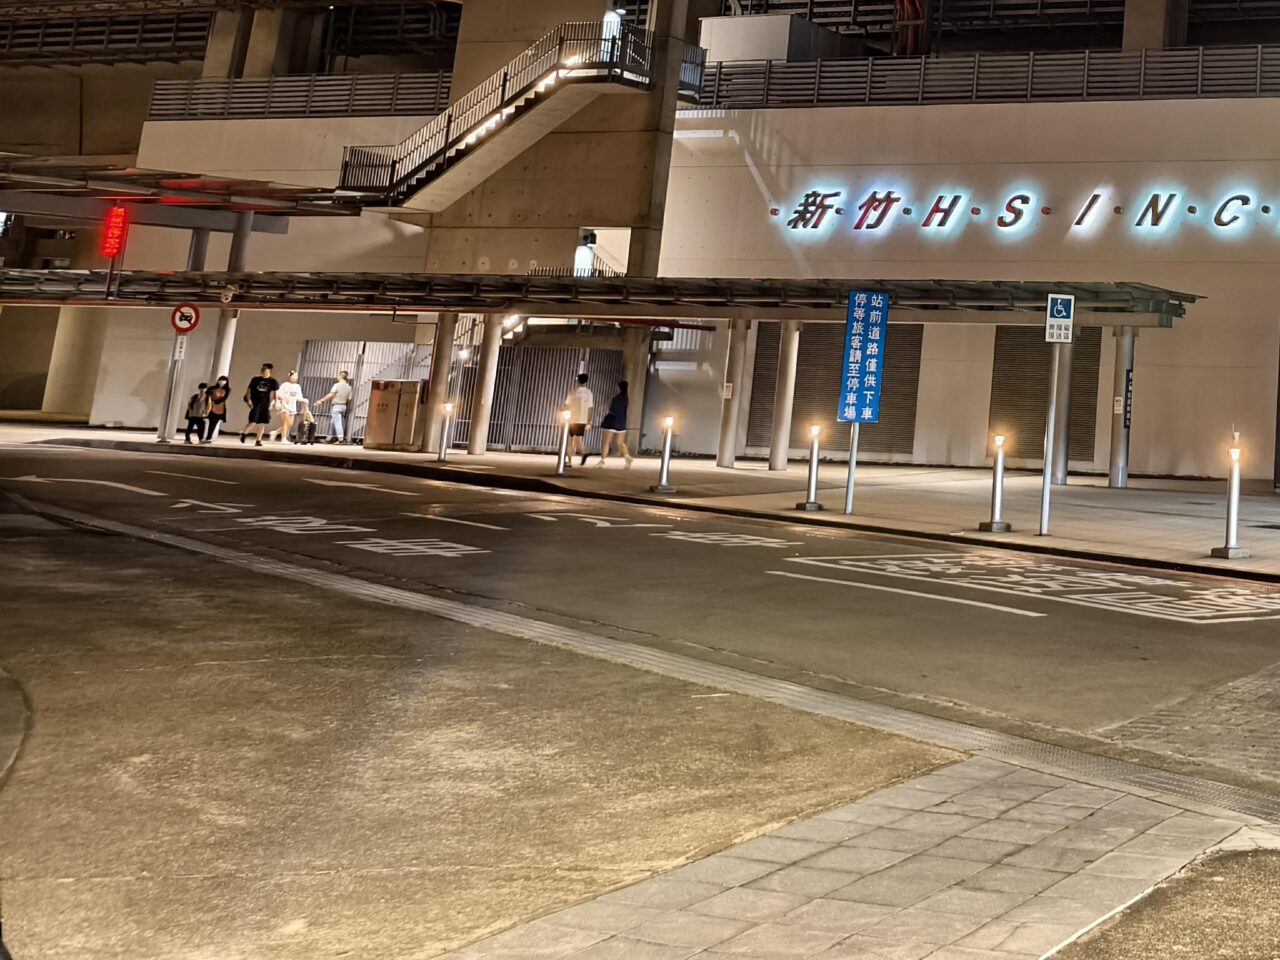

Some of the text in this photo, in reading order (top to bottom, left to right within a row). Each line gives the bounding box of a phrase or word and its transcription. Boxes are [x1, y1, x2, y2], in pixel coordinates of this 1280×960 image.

[787, 190, 901, 230] 新竹
[843, 292, 868, 420] 停等旅客請至停車場
[861, 294, 884, 420] 站前道路僅供下車
[521, 512, 807, 548] 公車
[836, 558, 1272, 617] 接送區
